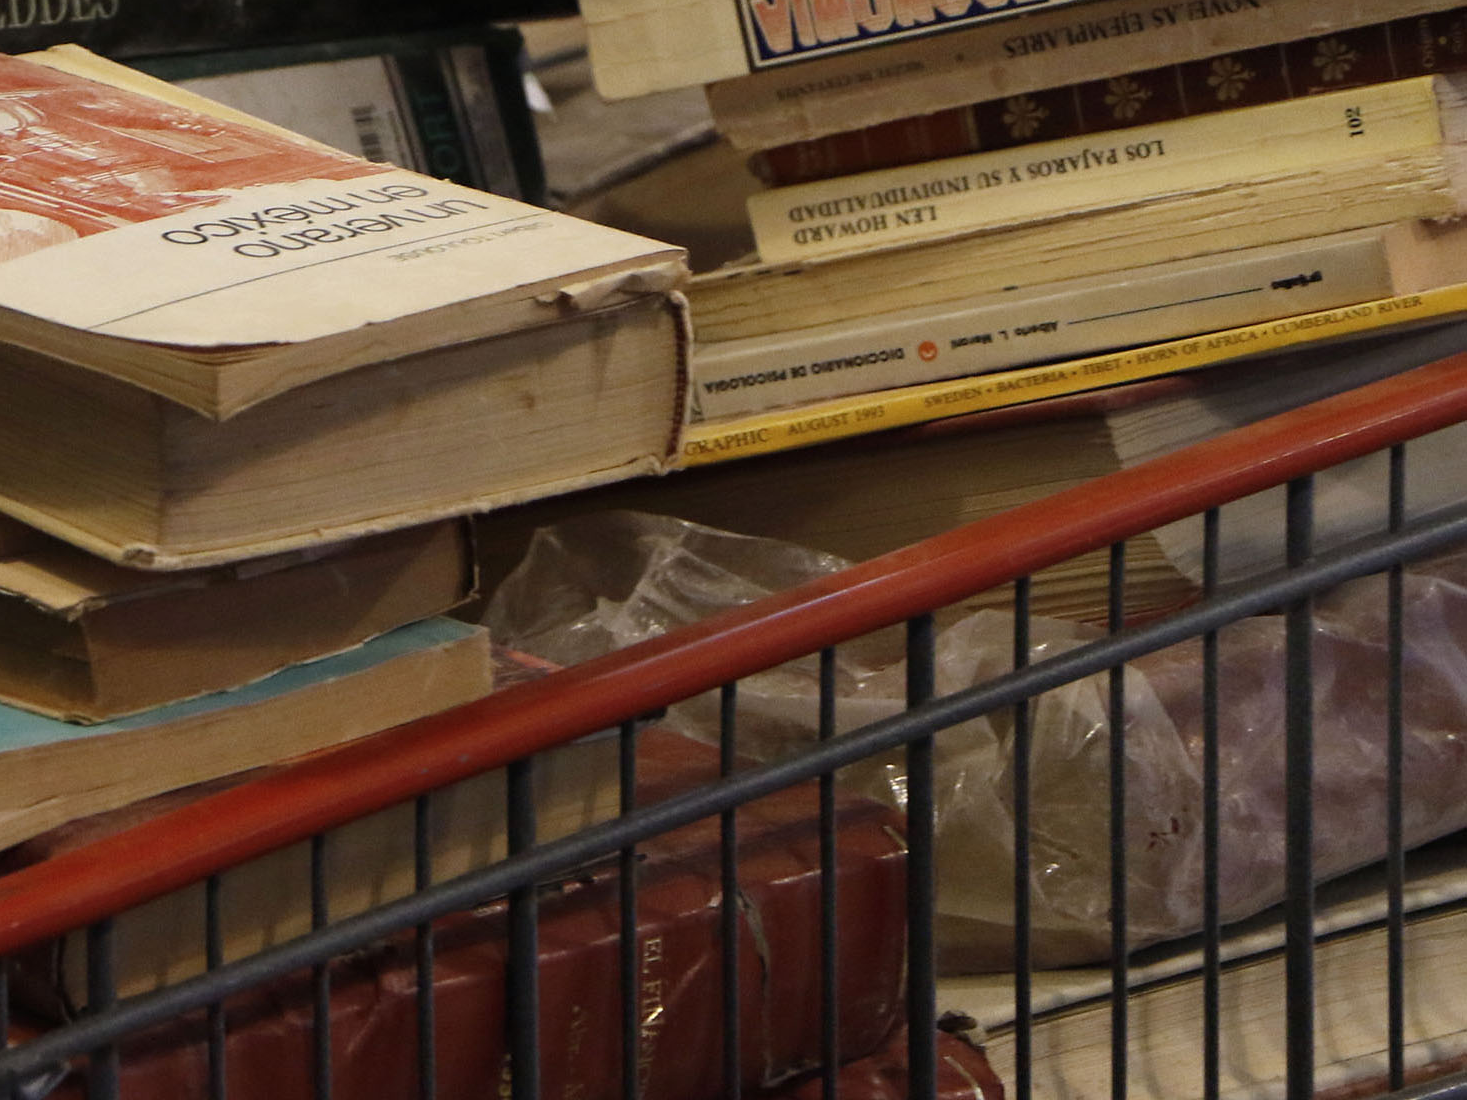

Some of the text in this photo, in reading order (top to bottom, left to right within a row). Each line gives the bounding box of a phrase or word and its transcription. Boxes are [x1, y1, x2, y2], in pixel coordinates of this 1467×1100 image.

[1003, 11, 1147, 60] EJEMPLARES
[1346, 105, 1364, 139] 102
[788, 140, 1166, 223] LOS PAJAROS Y SU INDIVIDUALIDAD
[161, 183, 429, 248] en méxico
[233, 198, 490, 260] un verano
[794, 205, 938, 246] LEN HOWARD
[1014, 319, 1059, 338] Alberto
[811, 347, 905, 376] DICCIONARIO
[924, 294, 1424, 408] SWEDEN BACTERIA TIBET HORN OF AFRICA CUMBERLAND RIVER
[790, 365, 808, 381] DE
[787, 410, 851, 437] AUGUST
